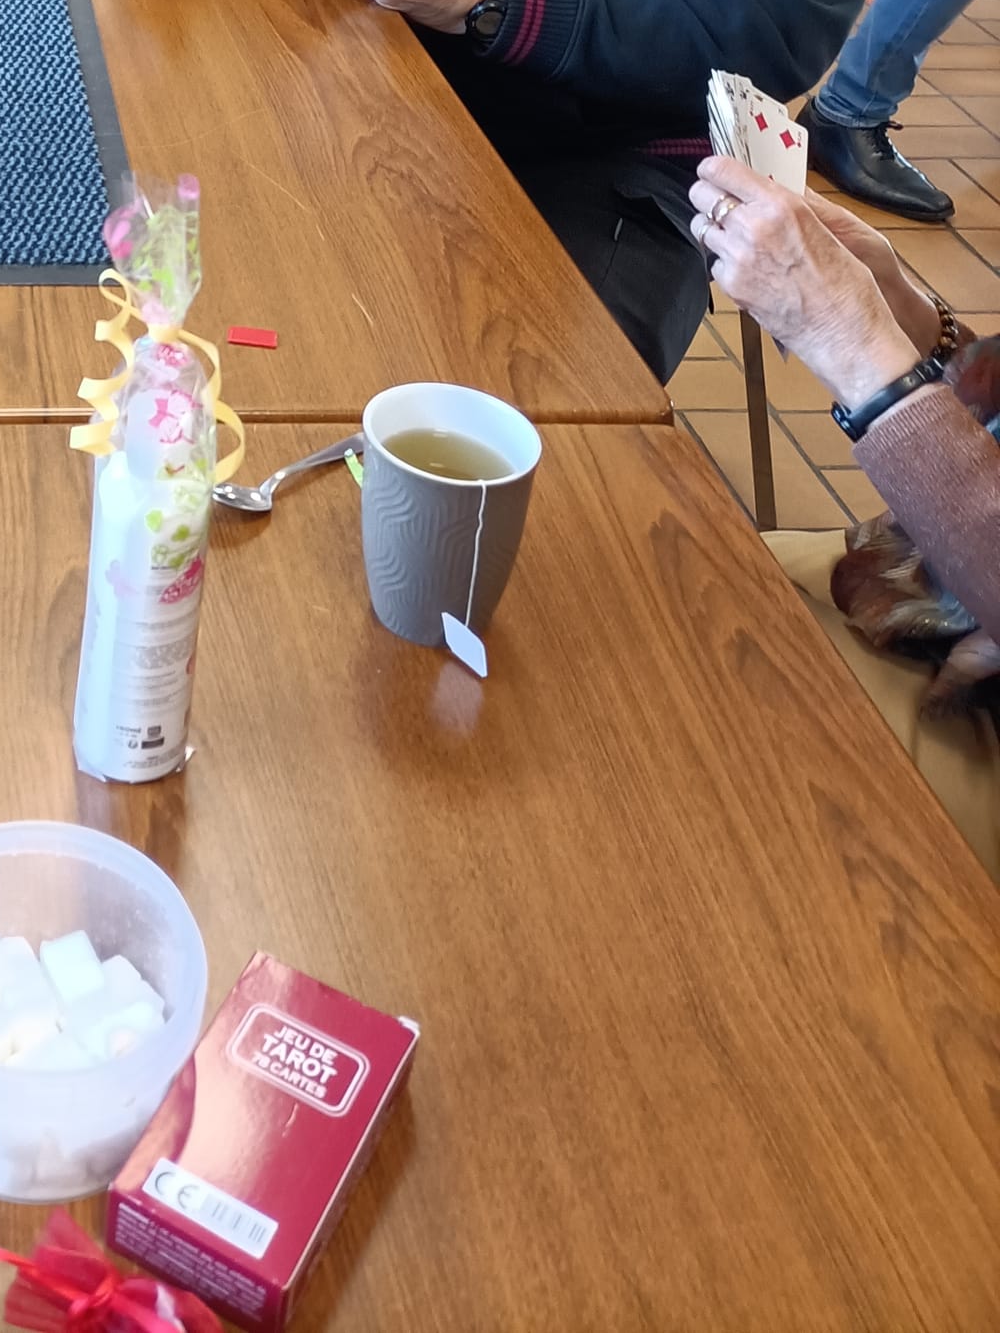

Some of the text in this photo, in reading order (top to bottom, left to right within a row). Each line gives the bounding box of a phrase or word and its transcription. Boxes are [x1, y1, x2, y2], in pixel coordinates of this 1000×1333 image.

[262, 1033, 338, 1084] TAROT
[273, 1026, 338, 1065] JEU DE
[251, 1051, 327, 1098] 78 CARTES
